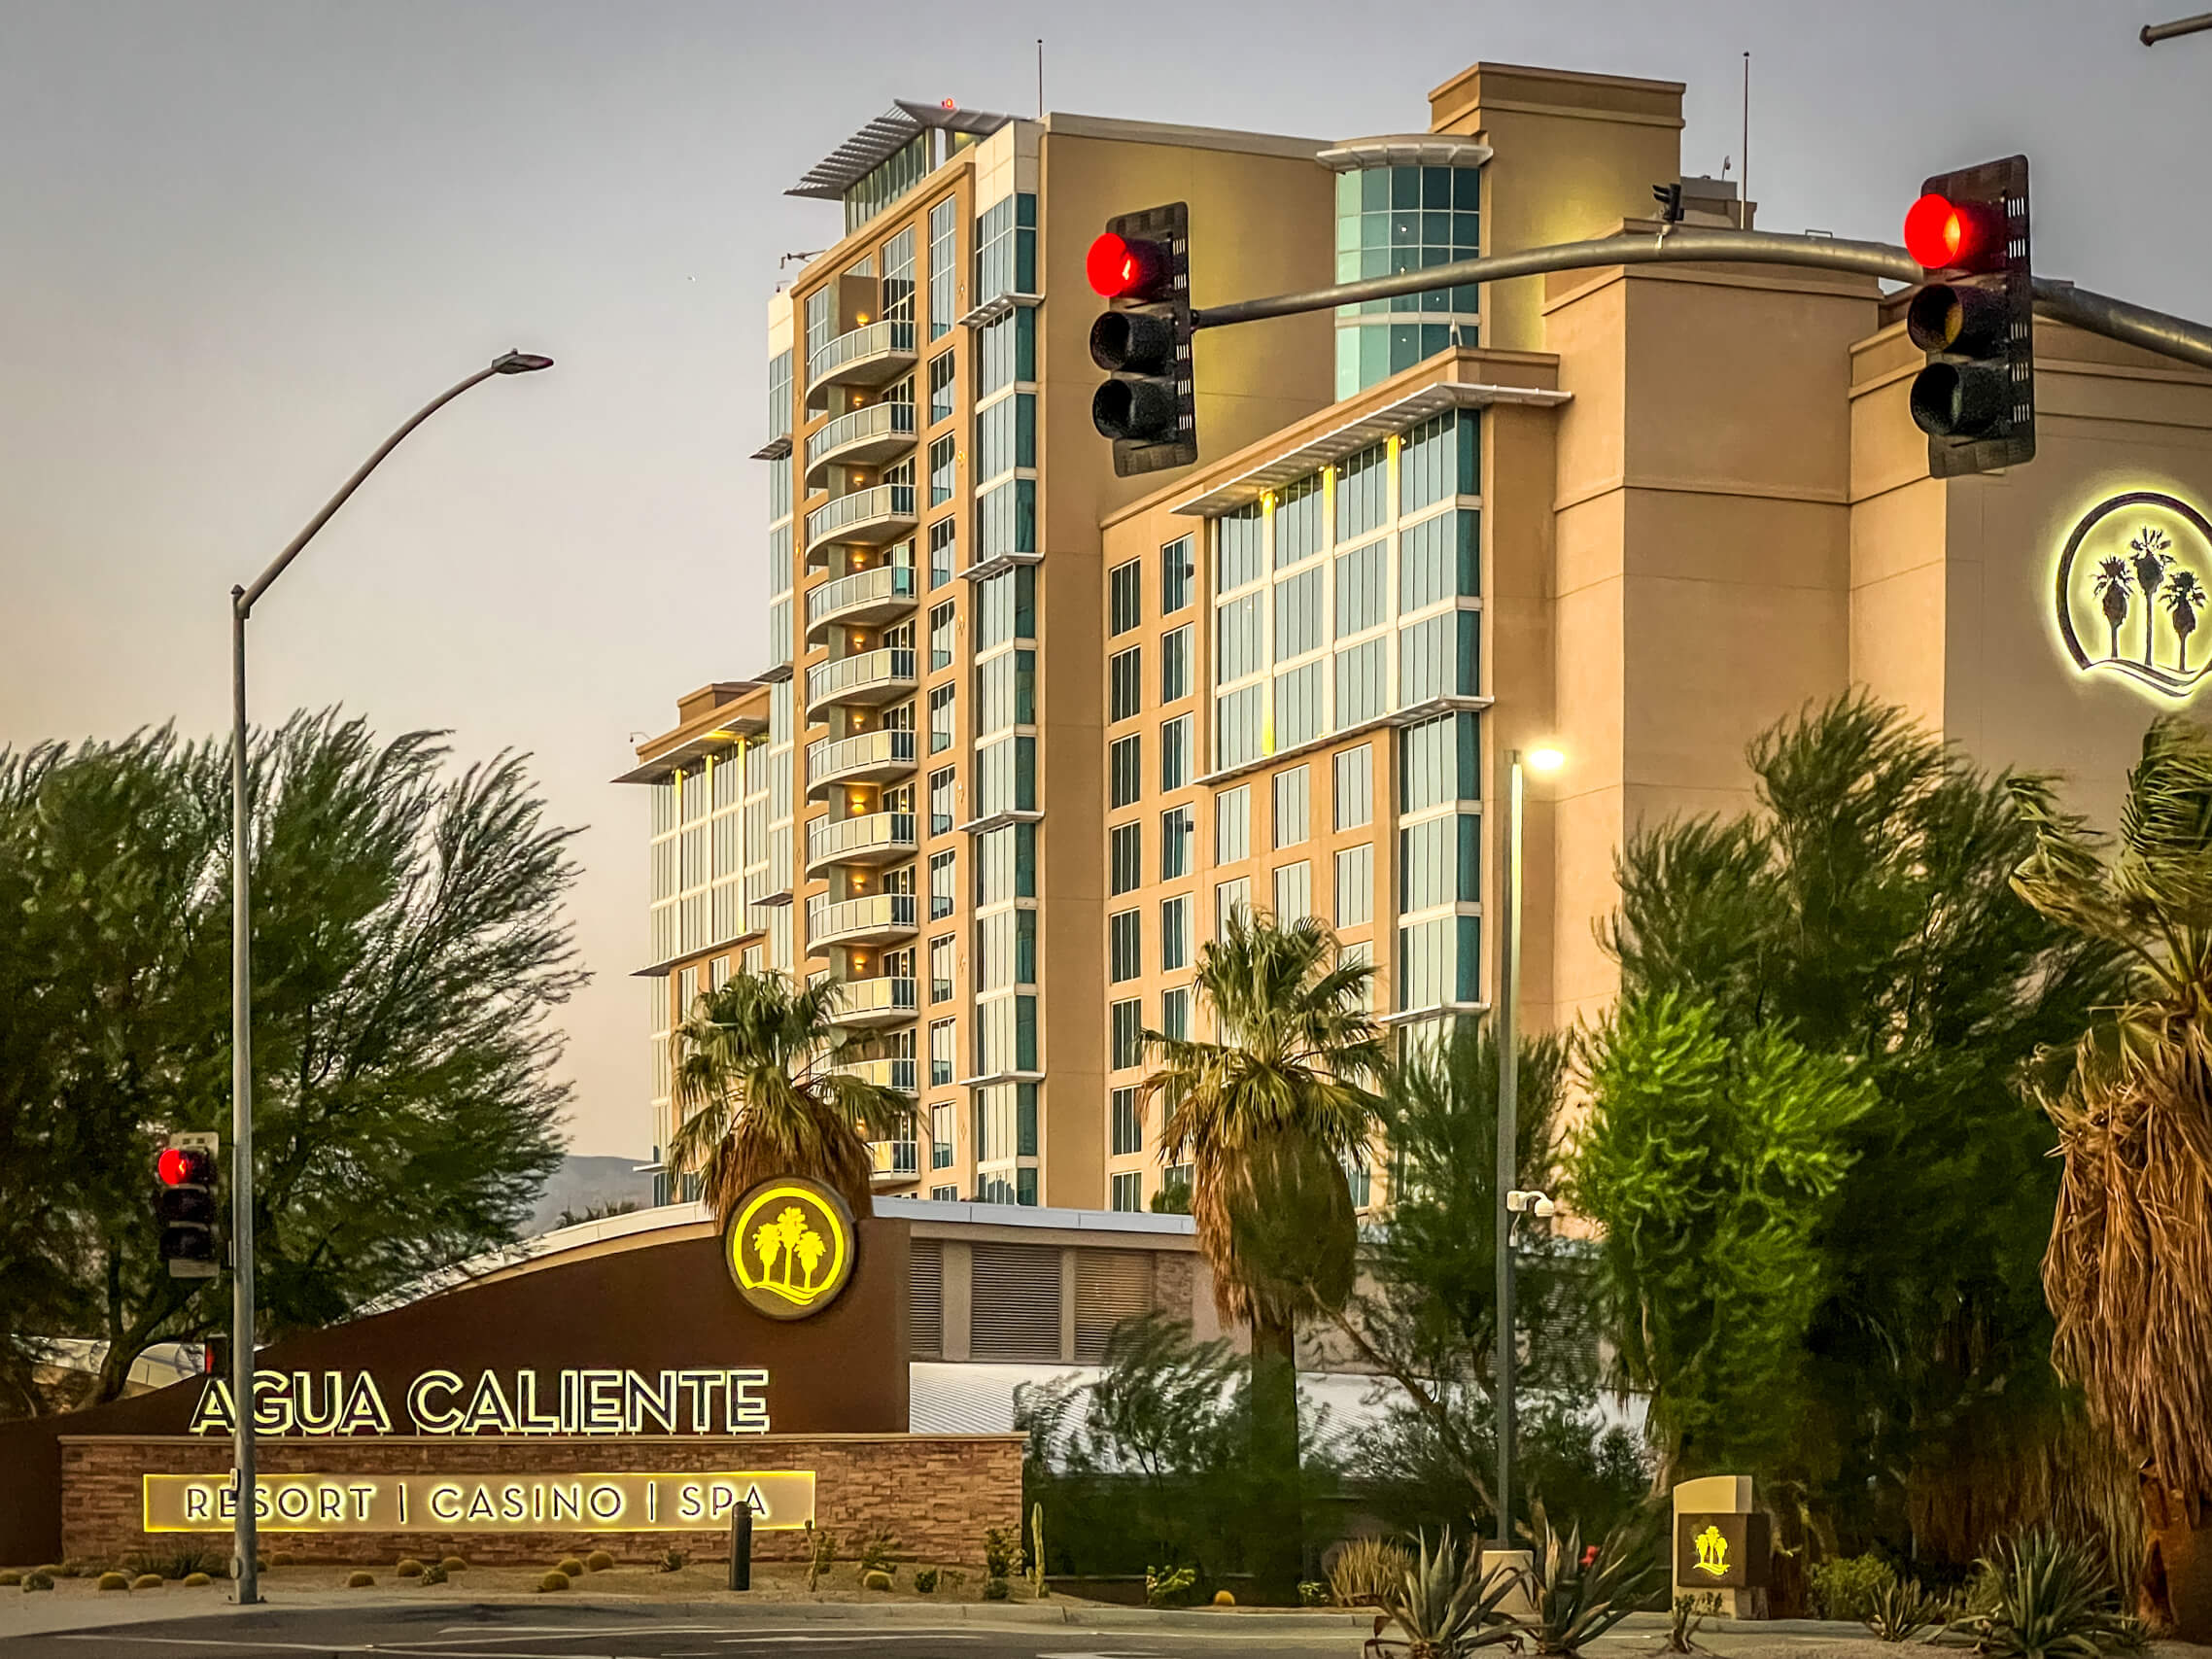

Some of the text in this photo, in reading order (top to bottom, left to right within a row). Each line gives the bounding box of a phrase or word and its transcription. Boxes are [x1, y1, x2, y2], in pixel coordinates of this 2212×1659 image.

[190, 1369, 772, 1434] AGUA CALIENTE
[186, 1487, 374, 1519] RESORT
[431, 1486, 622, 1518] CASINO
[680, 1485, 767, 1516] SPA
